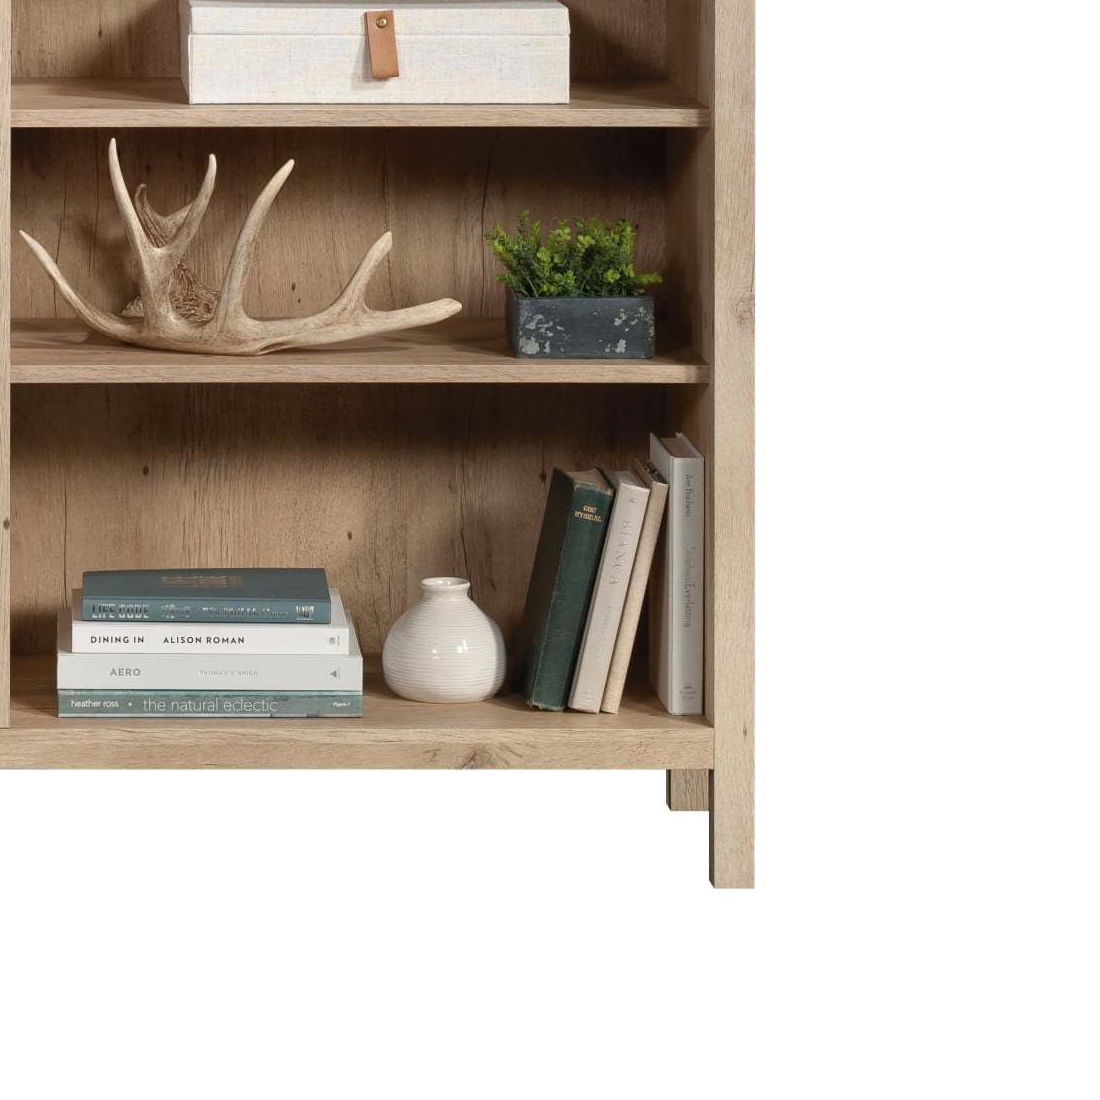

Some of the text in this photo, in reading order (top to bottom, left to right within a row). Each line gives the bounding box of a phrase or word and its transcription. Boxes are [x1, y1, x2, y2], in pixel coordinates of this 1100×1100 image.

[685, 474, 694, 487] Ann
[608, 519, 633, 588] BIANCA
[91, 603, 116, 619] LIFE
[118, 603, 150, 619] CODE
[90, 636, 145, 644] DINING IN
[163, 636, 245, 644] ALISON ROMAN
[109, 668, 141, 677] AERO
[70, 698, 120, 708] heather ross
[142, 697, 279, 712] the natural eclectic
